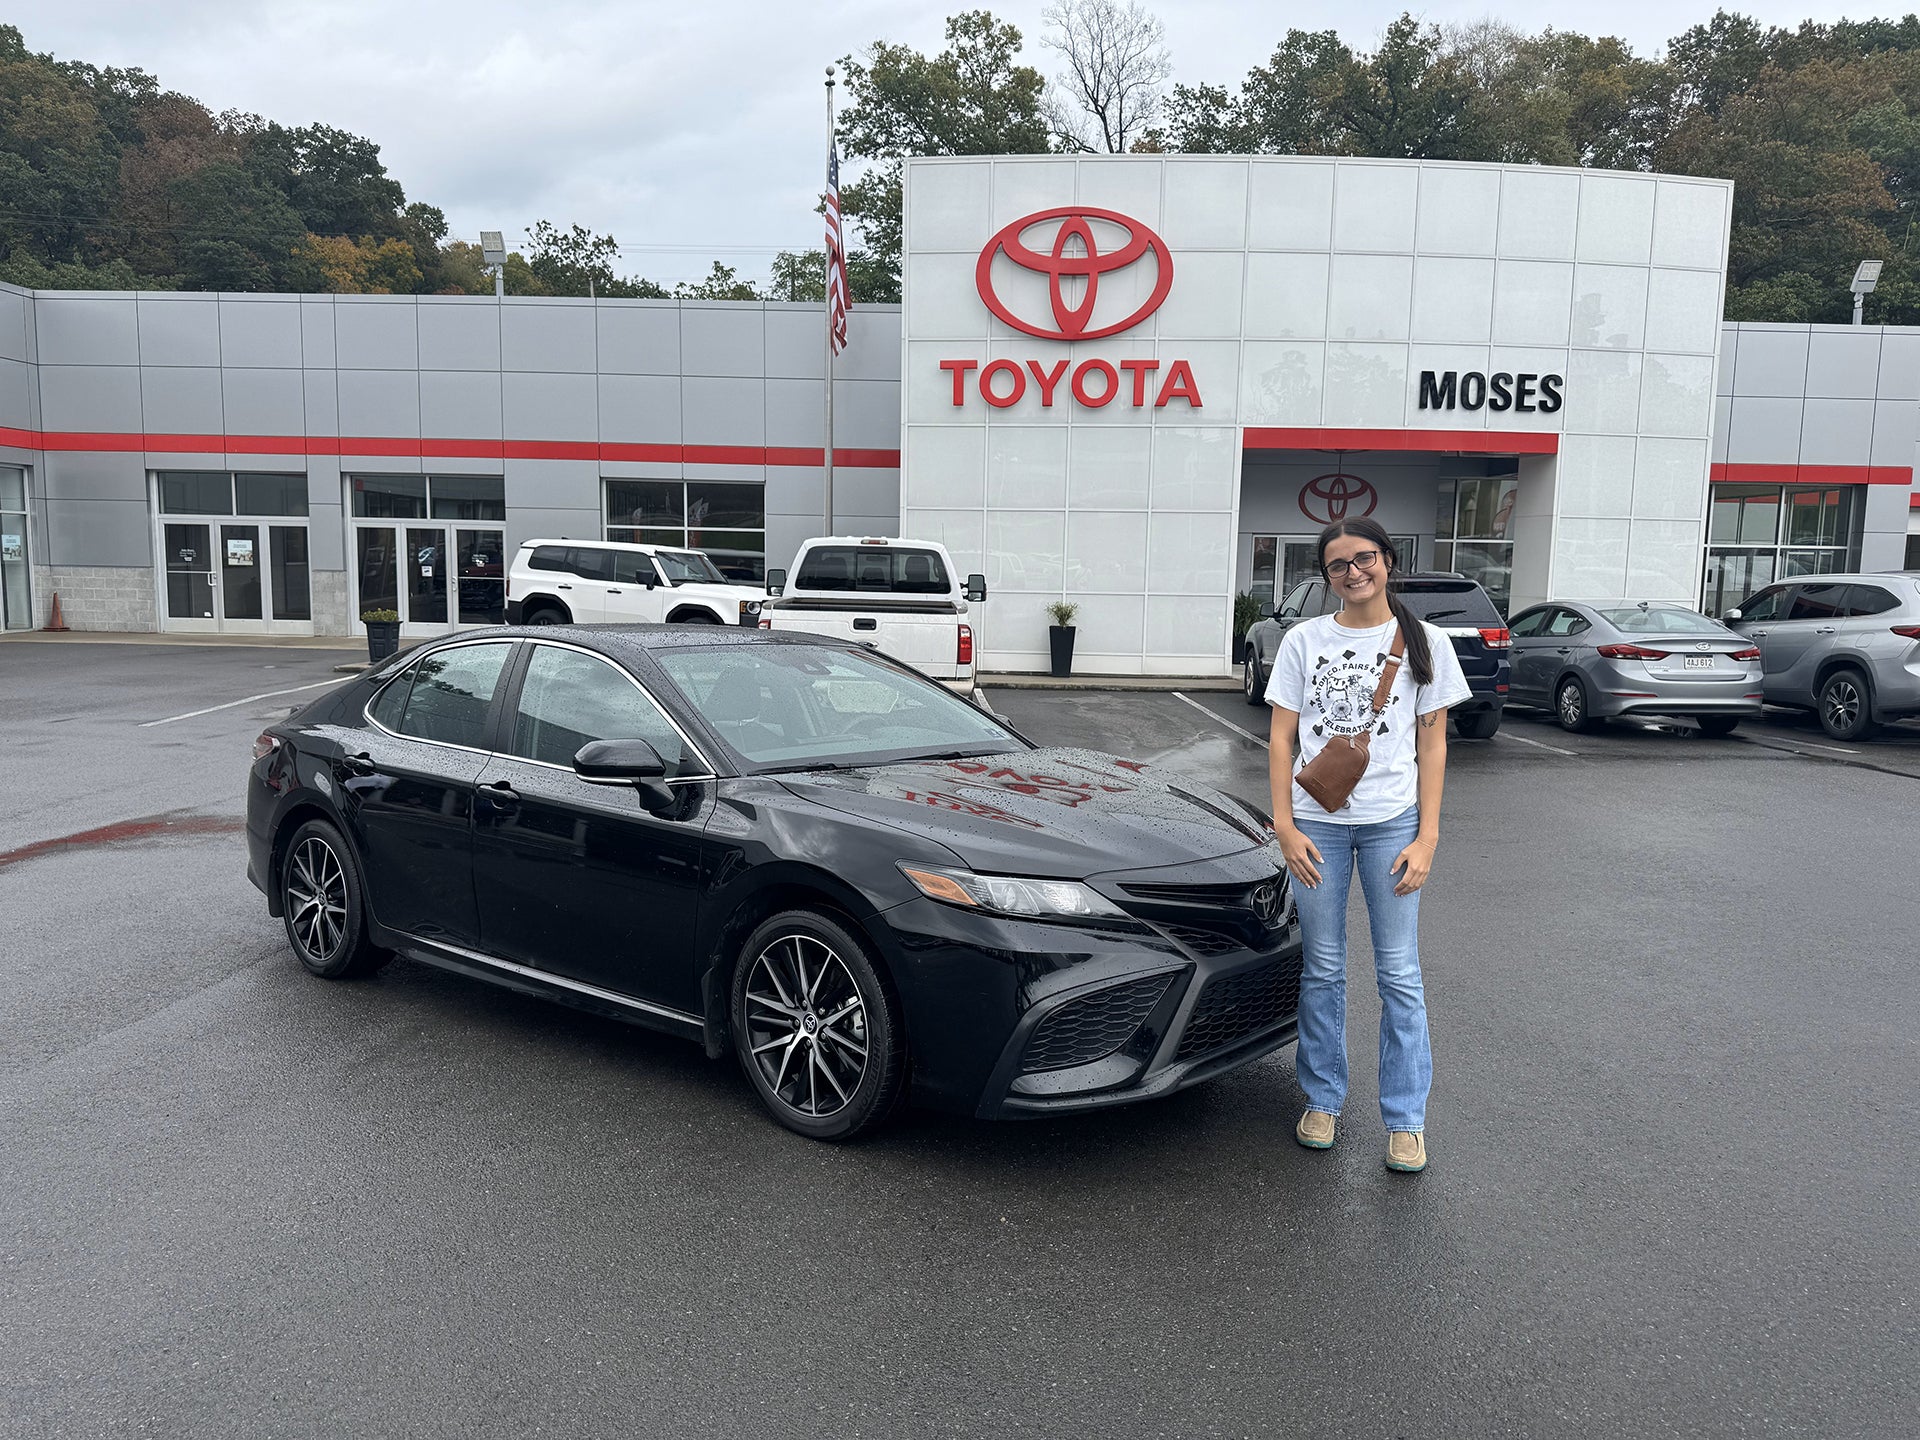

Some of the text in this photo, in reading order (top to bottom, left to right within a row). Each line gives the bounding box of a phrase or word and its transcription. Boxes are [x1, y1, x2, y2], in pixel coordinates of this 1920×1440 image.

[939, 359, 1203, 408] TOYOTA
[1418, 370, 1564, 413] MOSES
[1314, 675, 1328, 714] BRAXTON
[1327, 666, 1341, 677] CO.
[1369, 667, 1376, 675] &
